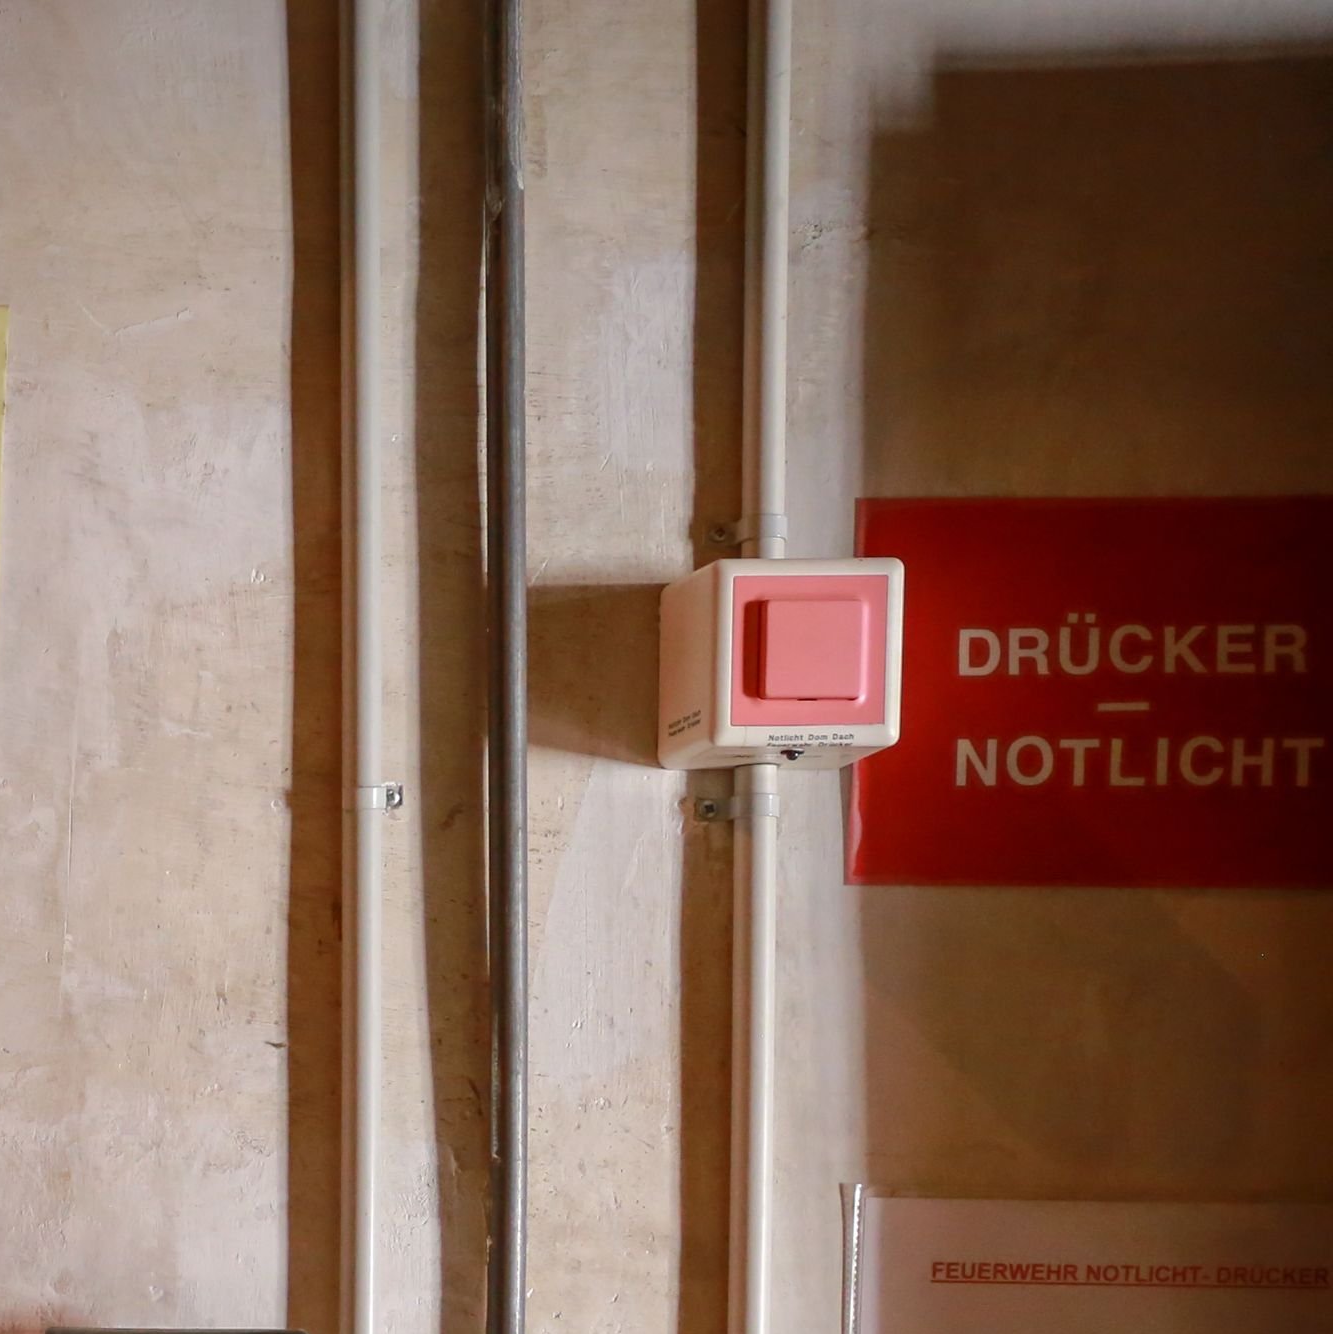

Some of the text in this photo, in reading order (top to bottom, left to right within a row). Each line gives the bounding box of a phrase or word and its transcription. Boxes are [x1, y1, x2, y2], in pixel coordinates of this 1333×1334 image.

[958, 613, 1307, 676] DRÜCKER
[808, 733, 828, 741] Dom
[955, 736, 1324, 786] NOTLICHT
[933, 1262, 1078, 1281] FEUERWEHR
